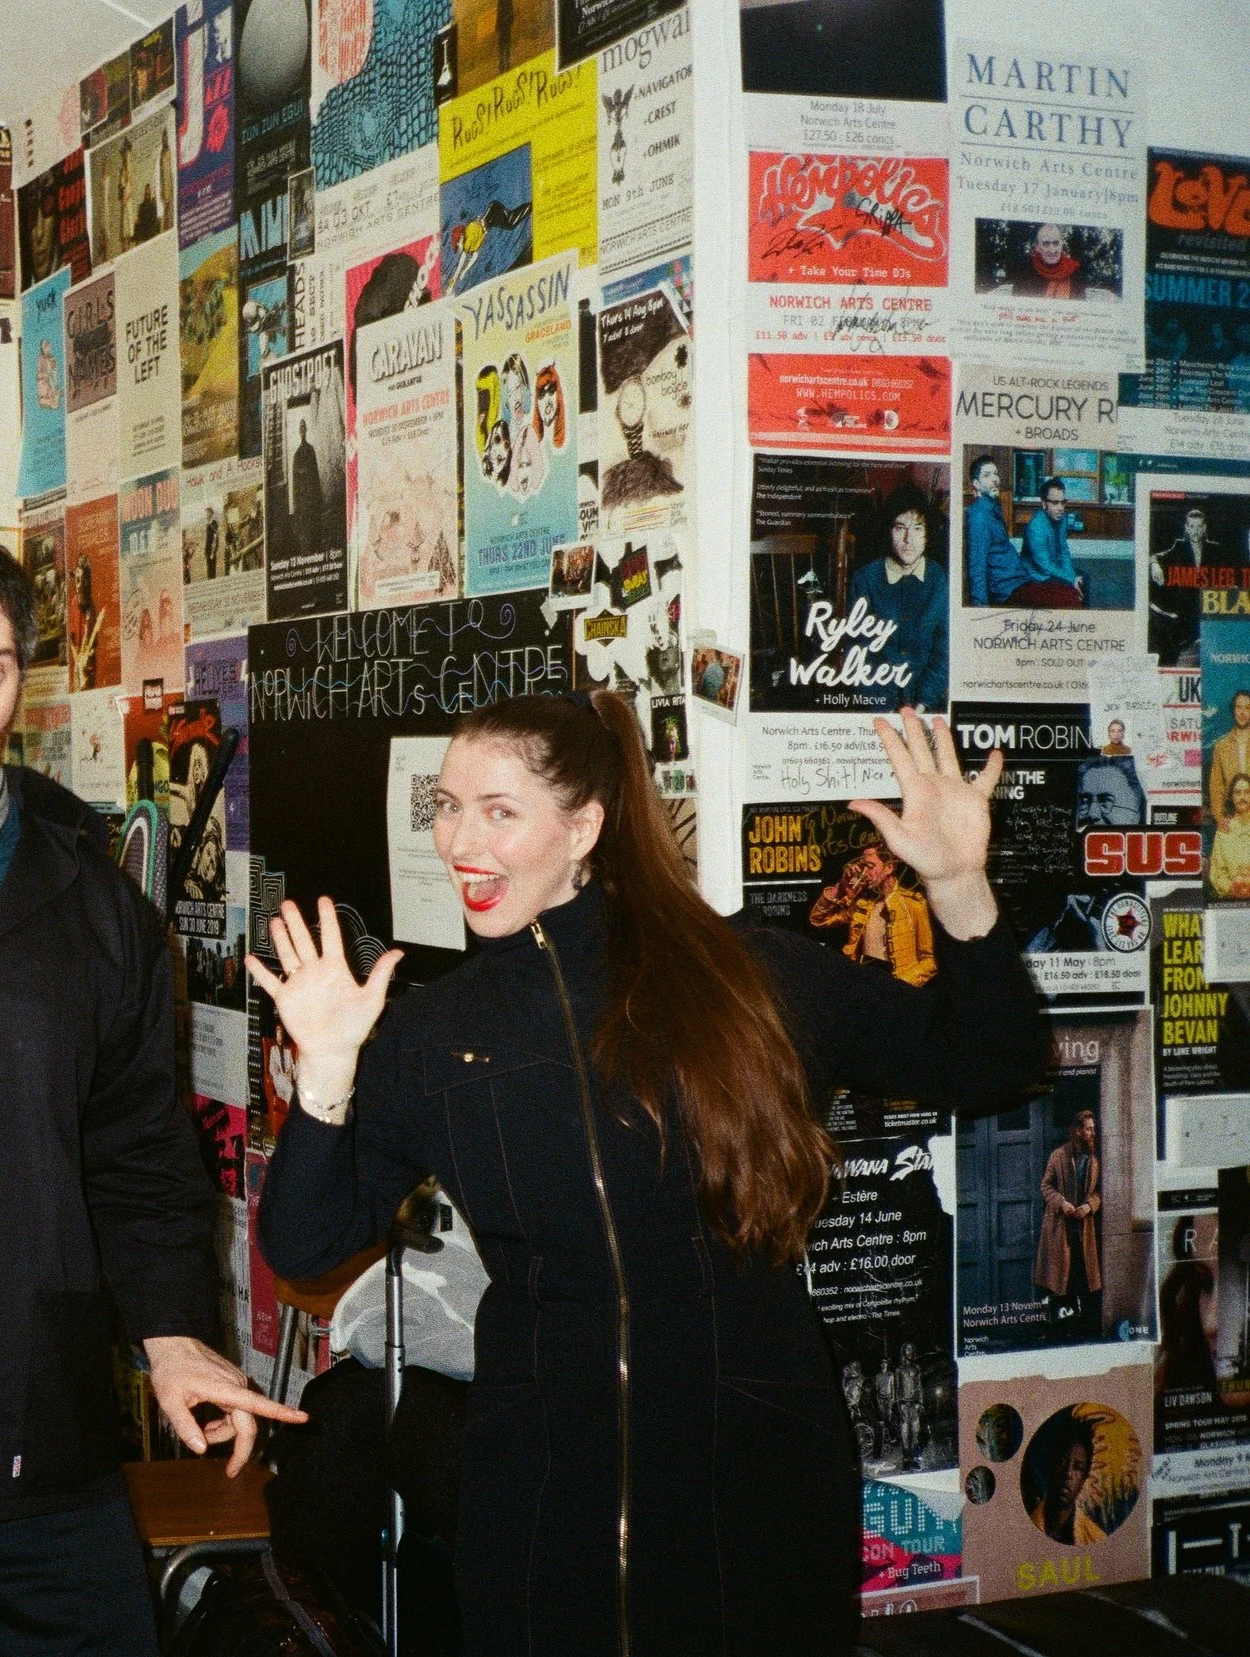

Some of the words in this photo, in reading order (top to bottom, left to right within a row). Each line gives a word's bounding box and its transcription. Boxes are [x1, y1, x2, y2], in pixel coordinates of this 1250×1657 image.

[602, 8, 692, 74] mogwai
[966, 53, 1131, 100] MARTIN
[810, 99, 851, 115] Monday
[866, 102, 887, 117] July
[801, 114, 841, 128] Norwich
[843, 116, 864, 130] Arts
[865, 117, 897, 130] Centre
[963, 104, 1134, 149] CARTHY
[960, 152, 1032, 173] Norwich
[1039, 158, 1075, 177] Arts
[1081, 161, 1139, 181] Centre
[956, 175, 1017, 197] Tuesday
[1023, 182, 1040, 196] 17
[800, 265, 827, 277] Take
[832, 266, 858, 278] Your
[862, 267, 889, 279] Time
[1145, 271, 1233, 307] SUMMER
[462, 264, 572, 341] YASSASSIN
[769, 295, 831, 310] NORWICH
[839, 296, 874, 311] ARTS
[882, 297, 932, 311] CENTRE
[66, 290, 116, 340] GIRLS
[125, 304, 169, 343] FUTURE
[127, 342, 144, 362] OF
[146, 329, 168, 354] THE
[371, 324, 443, 383] CARAVAN
[133, 355, 161, 385] LEFT
[992, 375, 1007, 386] US
[1008, 376, 1060, 389] ALT-ROCK
[1062, 379, 1109, 392] LEGENDS
[400, 400, 420, 417] ARTS
[955, 391, 1086, 422] MERCURY
[1024, 426, 1079, 442] BROADS
[1166, 565, 1209, 588] JAMES
[316, 603, 430, 664] WELCOME
[439, 598, 485, 652] TO
[804, 596, 898, 653] Ryley
[1003, 618, 1045, 636] Friday
[973, 637, 1038, 651] NORWICH
[1039, 638, 1073, 652] ARTS
[1076, 639, 1126, 652] CENTRE
[788, 643, 913, 688] Walker
[1040, 658, 1065, 668] SOLD
[250, 662, 350, 725] NORWICH
[357, 657, 426, 719] ARTS
[822, 692, 851, 708] Holly
[852, 694, 887, 706] Macve
[761, 725, 800, 737] Norwich
[802, 726, 819, 737] Arts
[821, 727, 852, 739] Centre
[956, 723, 1016, 751] TOM
[1016, 770, 1047, 785] THE
[748, 814, 803, 844] JOHN
[748, 842, 822, 875] ROBINS
[1063, 957, 1087, 970] May
[1162, 992, 1230, 1019] JOHNNY
[1162, 1019, 1219, 1046] BEVAN
[841, 1190, 879, 1205] Estère
[859, 1211, 873, 1225] 14
[874, 1209, 903, 1225] June
[830, 1237, 854, 1250] Arts
[855, 1234, 894, 1249] Centre
[902, 1229, 928, 1245] 8pm
[850, 1256, 889, 1272] £16.00
[890, 1253, 917, 1267] door
[962, 1304, 998, 1317] Monday
[962, 1316, 999, 1329] Norwich
[1000, 1314, 1019, 1325] Arts
[1192, 1417, 1213, 1428] TOUR
[1193, 1456, 1234, 1469] Monday
[900, 1538, 947, 1556] TOUR
[886, 1567, 909, 1583] Bug
[910, 1561, 943, 1578] Teeth
[1015, 1556, 1102, 1592] SAUL
